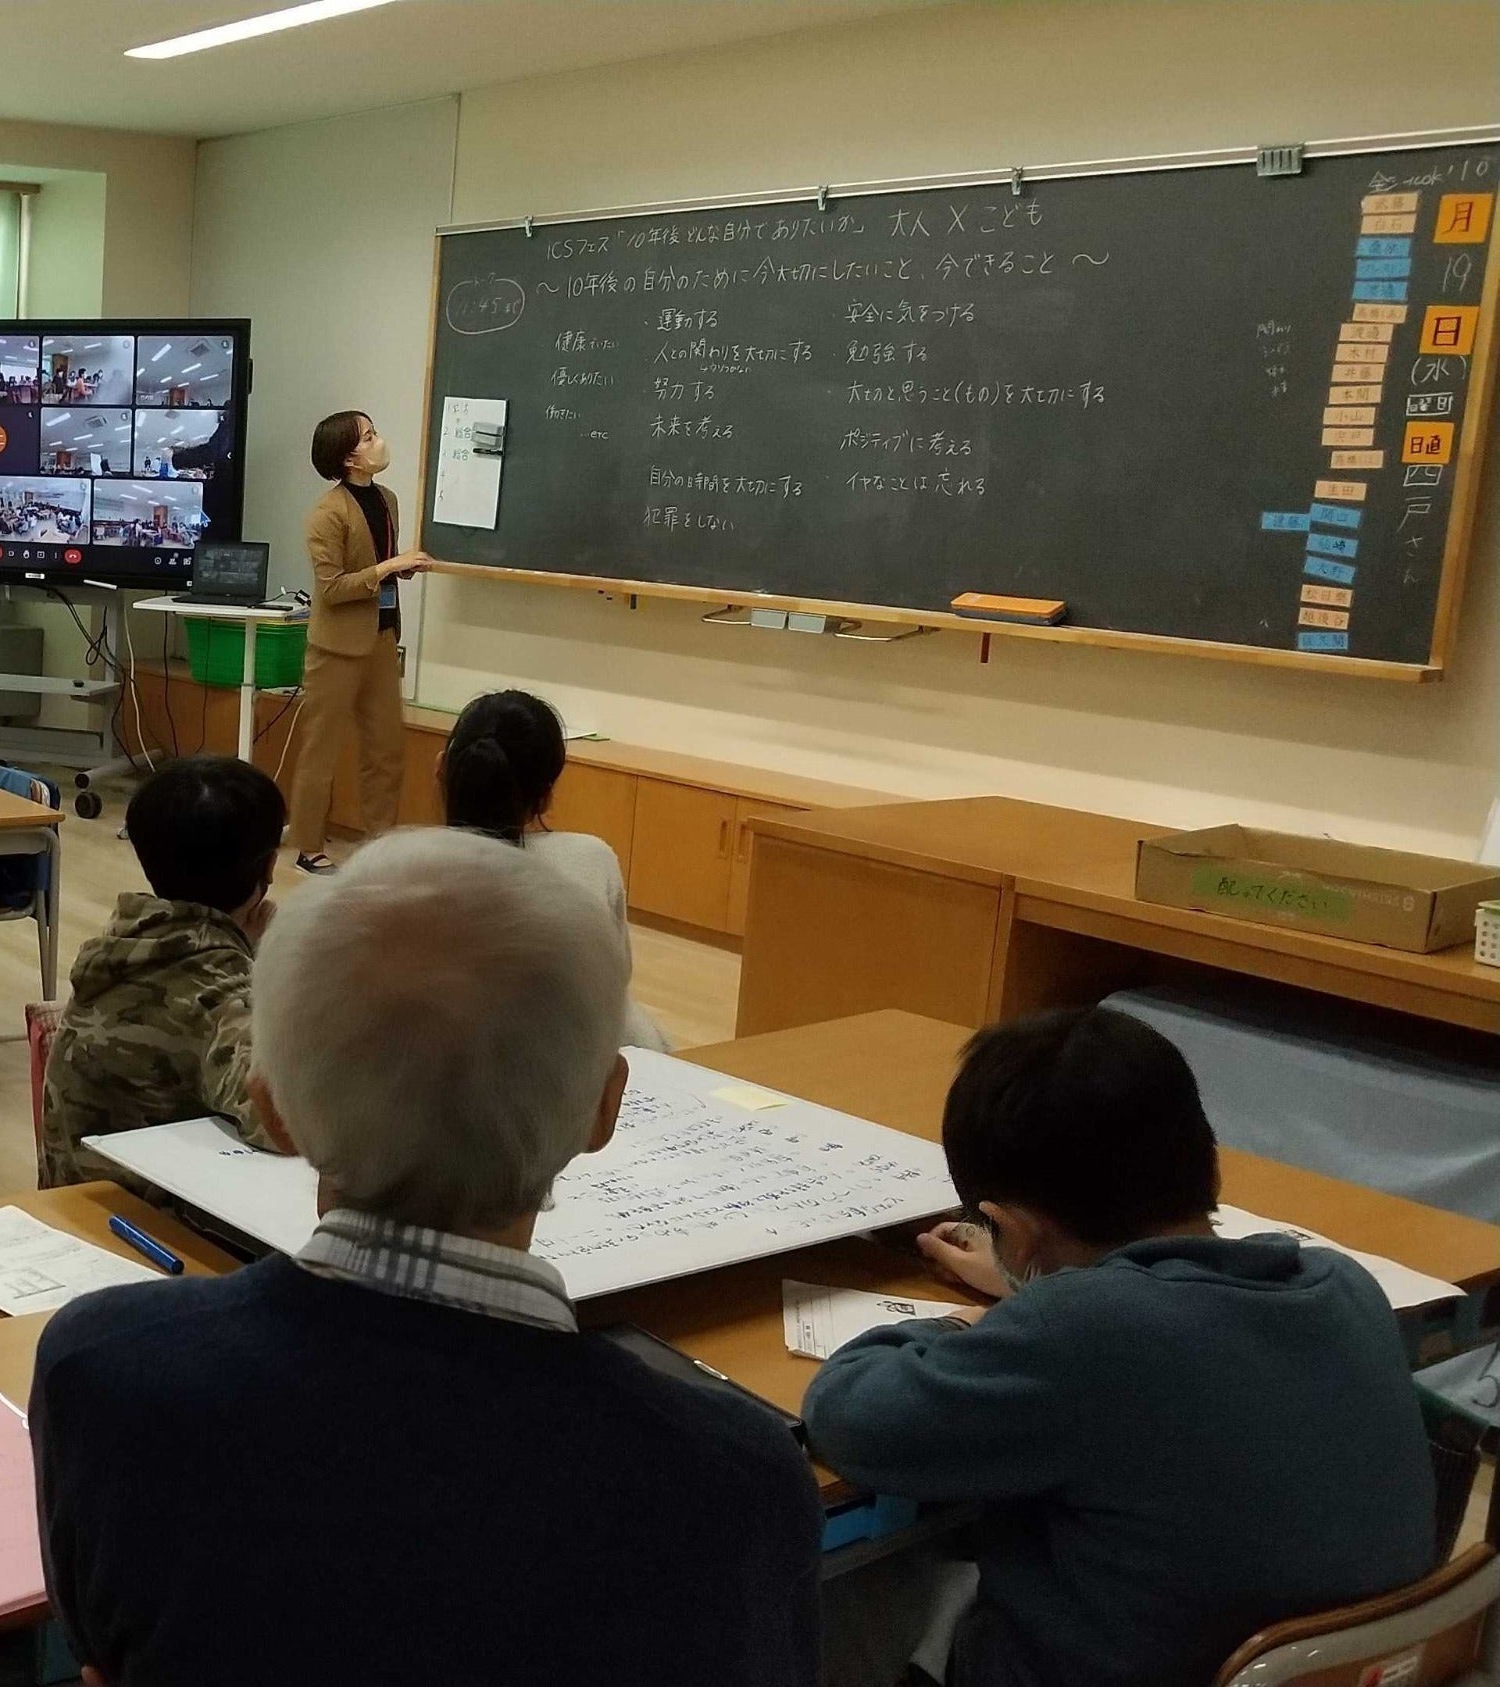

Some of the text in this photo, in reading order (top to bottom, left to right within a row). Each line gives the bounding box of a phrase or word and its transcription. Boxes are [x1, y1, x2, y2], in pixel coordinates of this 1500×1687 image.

[1441, 201, 1474, 234] 月
[1442, 253, 1472, 292] 19
[656, 308, 719, 332] 運動する
[844, 298, 975, 327] 安全に気をつける
[1432, 316, 1461, 346] 日
[653, 337, 813, 364] 人との関わりを大切にする
[846, 339, 928, 365] 勉強する
[551, 366, 614, 387] 優しくありたい
[653, 377, 715, 401] 努力する
[650, 413, 734, 439] 未来を考える
[840, 427, 974, 455] ポジティブに考える
[1410, 434, 1442, 455] 日直
[650, 465, 803, 499] 自分の時間を大切にする
[846, 467, 986, 496] イヤなことは忘れる
[643, 505, 736, 532] 犯罪をしない
[1217, 877, 1329, 909] 配ってください
